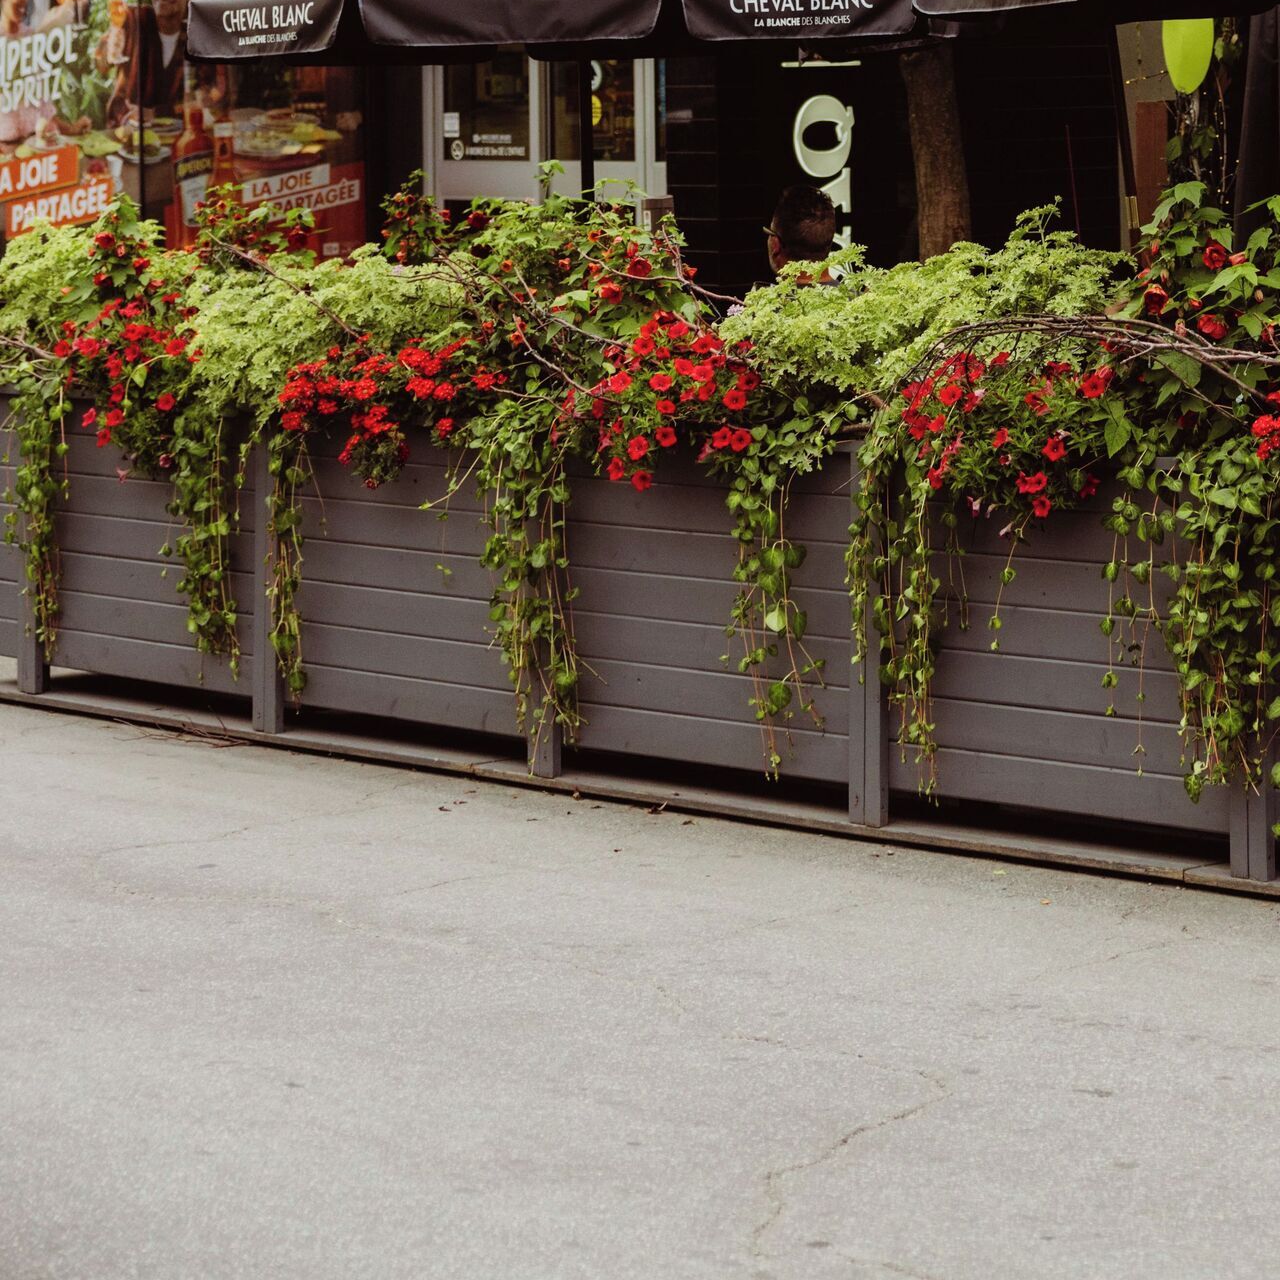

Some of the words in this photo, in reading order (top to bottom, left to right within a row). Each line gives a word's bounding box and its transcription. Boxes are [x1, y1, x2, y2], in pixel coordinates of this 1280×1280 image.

[222, 6, 269, 32] CHEVAL
[272, 1, 314, 28] BLANC
[754, 18, 764, 27] LA
[766, 17, 800, 27] BLANCHE
[801, 16, 813, 26] DES
[814, 14, 851, 25] BLANCHES
[0, 166, 12, 195] A
[16, 154, 58, 191] JOIE
[252, 181, 272, 198] LA
[276, 171, 313, 193] JOIE
[11, 178, 108, 232] PARTAGÉE
